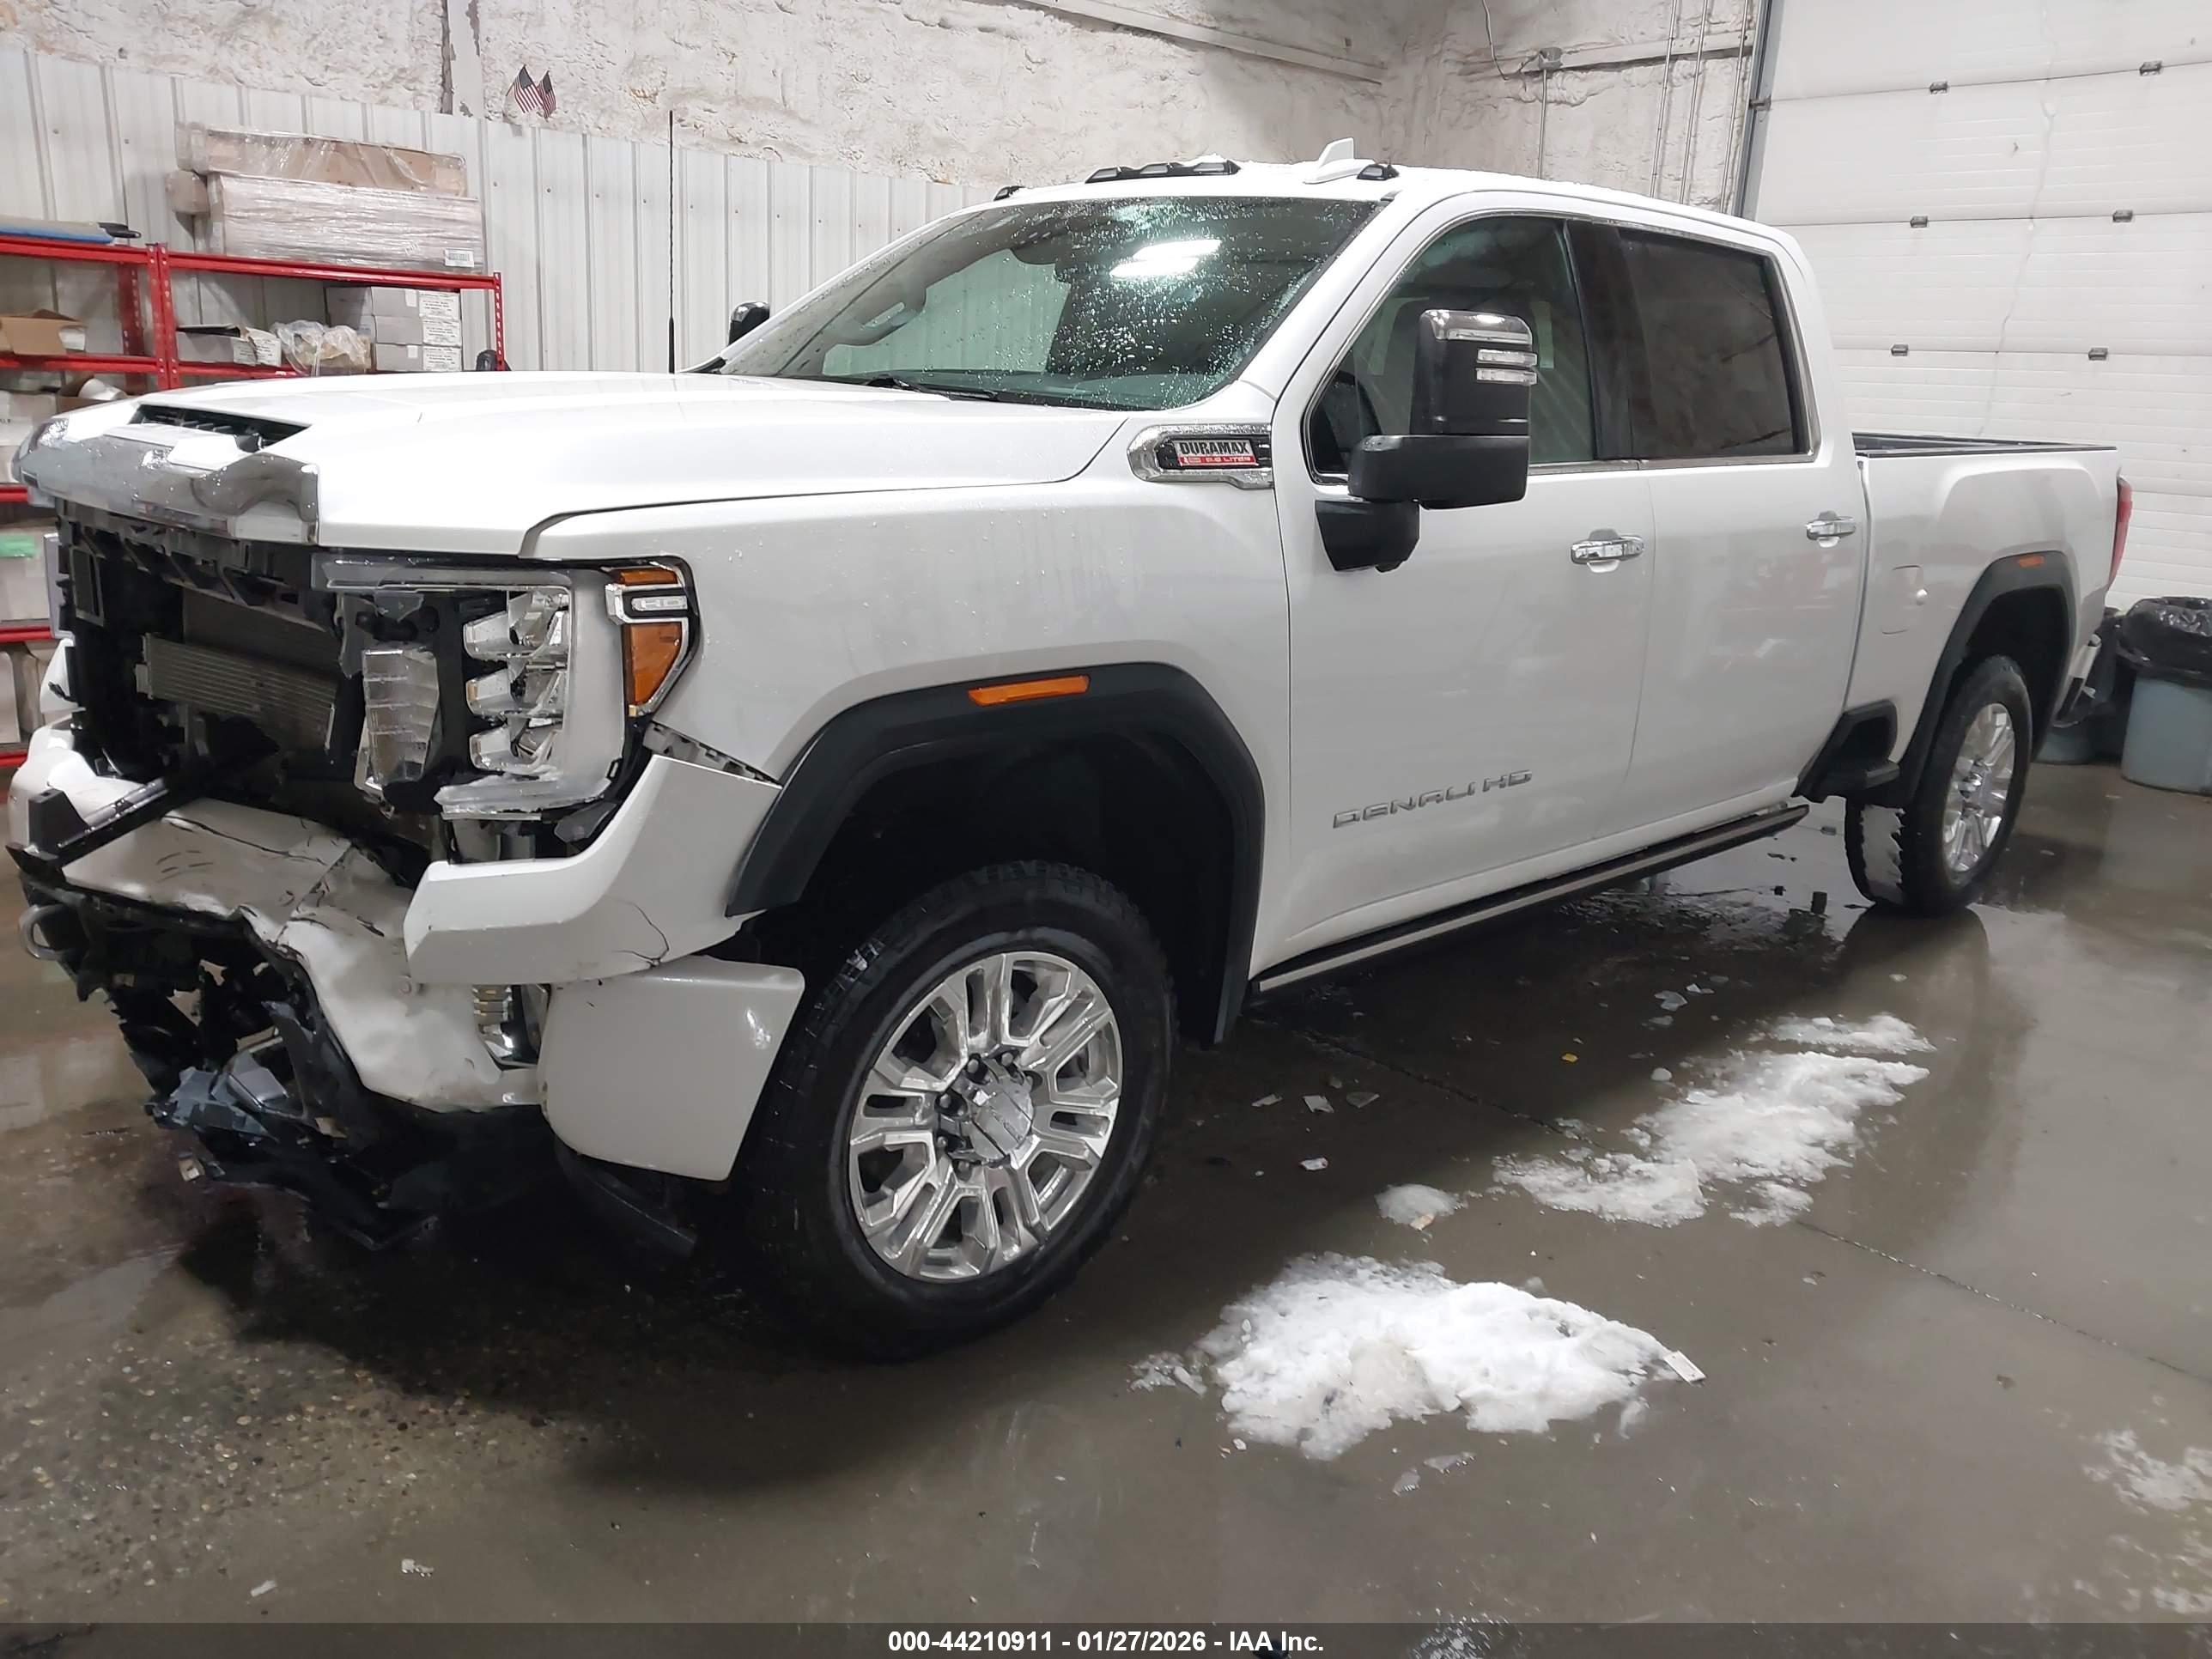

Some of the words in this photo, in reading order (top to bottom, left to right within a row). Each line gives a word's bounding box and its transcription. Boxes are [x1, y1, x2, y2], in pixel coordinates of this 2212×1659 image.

[1179, 441, 1250, 455] DURAMAX
[1332, 781, 1476, 830] DENALI
[1481, 769, 1533, 793] HD
